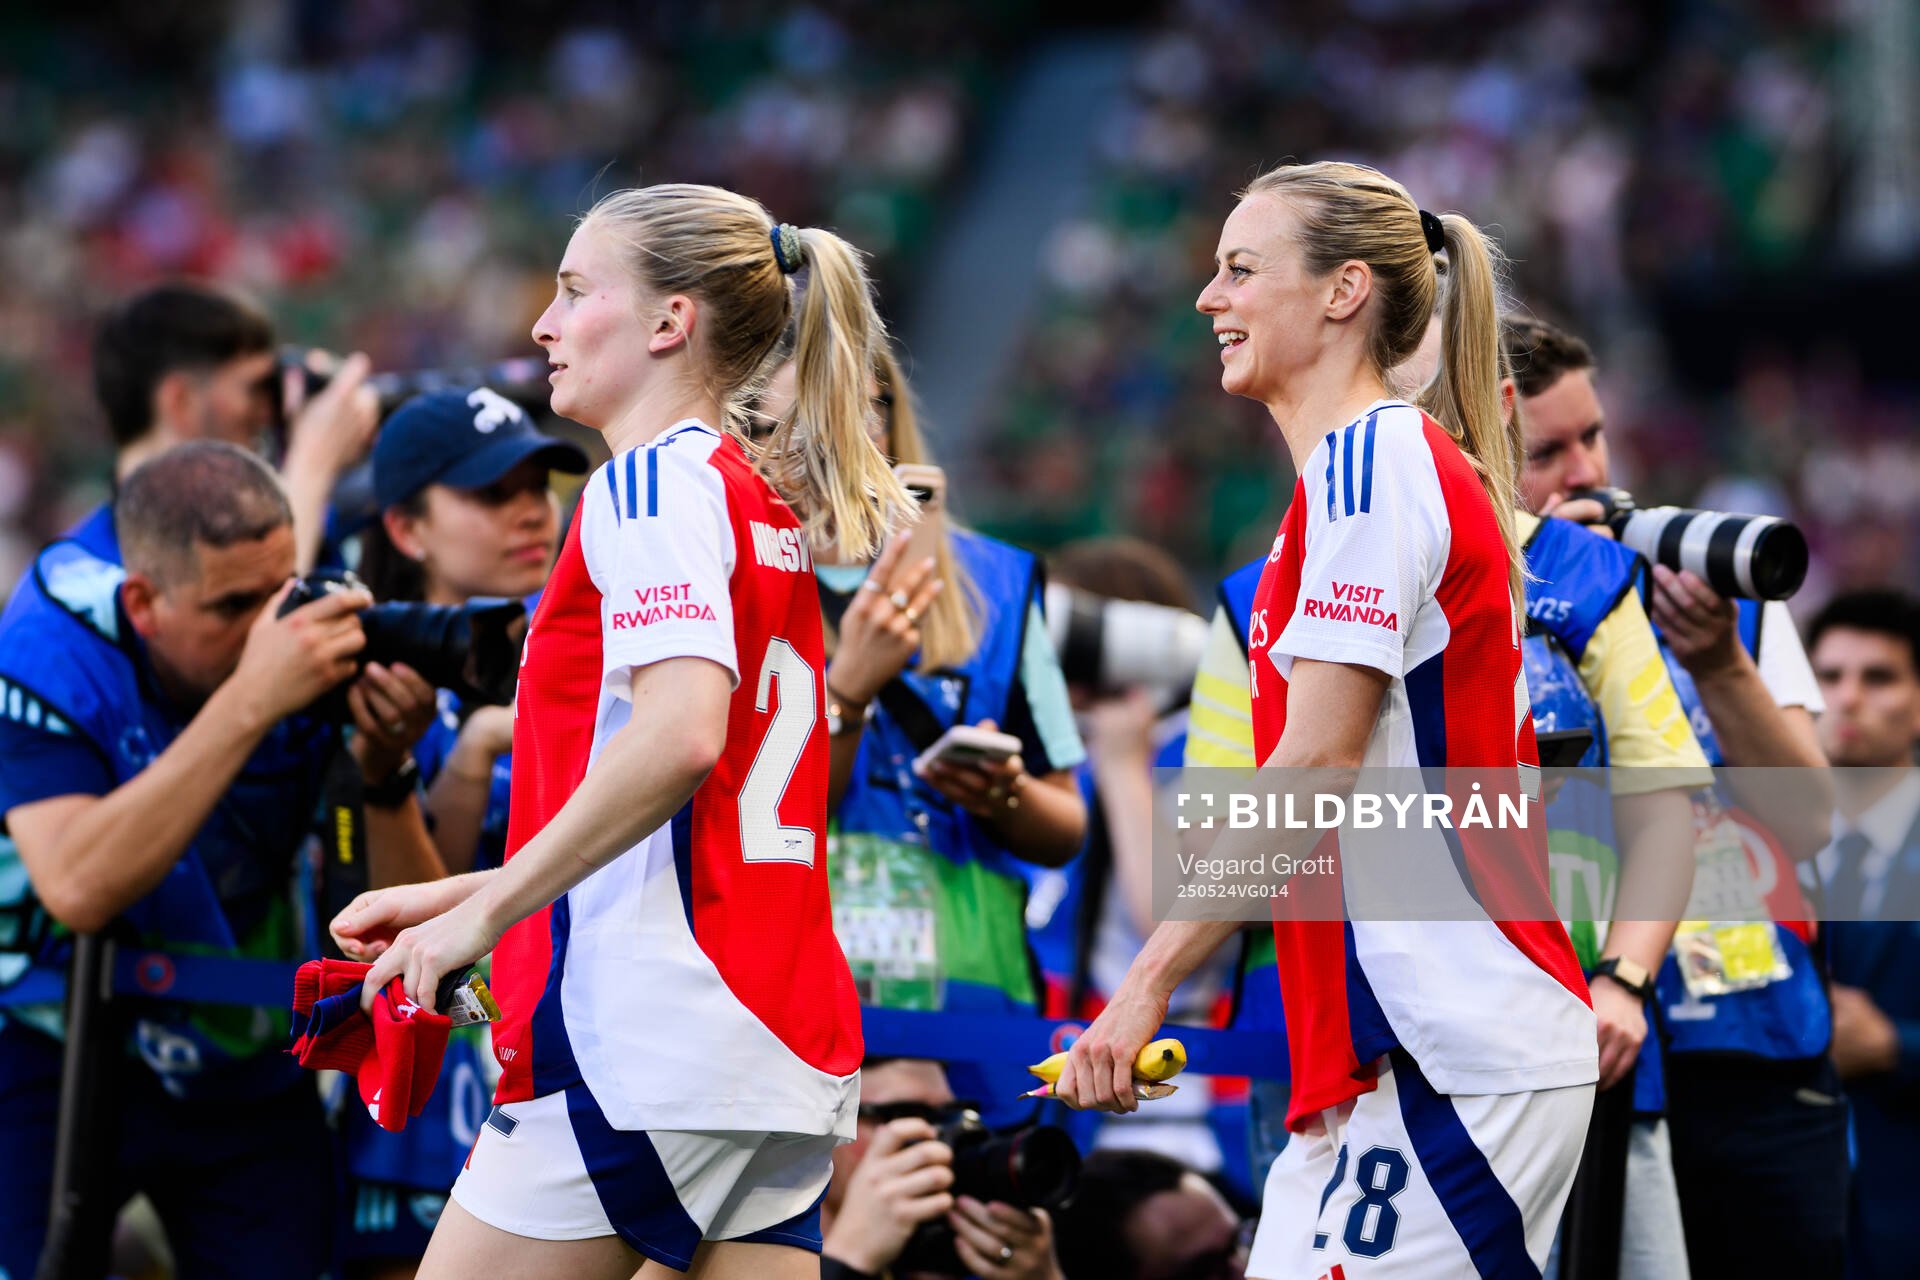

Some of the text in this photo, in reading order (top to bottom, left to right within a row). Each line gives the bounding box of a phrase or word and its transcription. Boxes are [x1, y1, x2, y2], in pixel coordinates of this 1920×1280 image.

[634, 583, 691, 605] VISIT
[1331, 581, 1384, 605] VISIT
[613, 604, 717, 630] RWANDA
[1303, 598, 1398, 632] RWANDA
